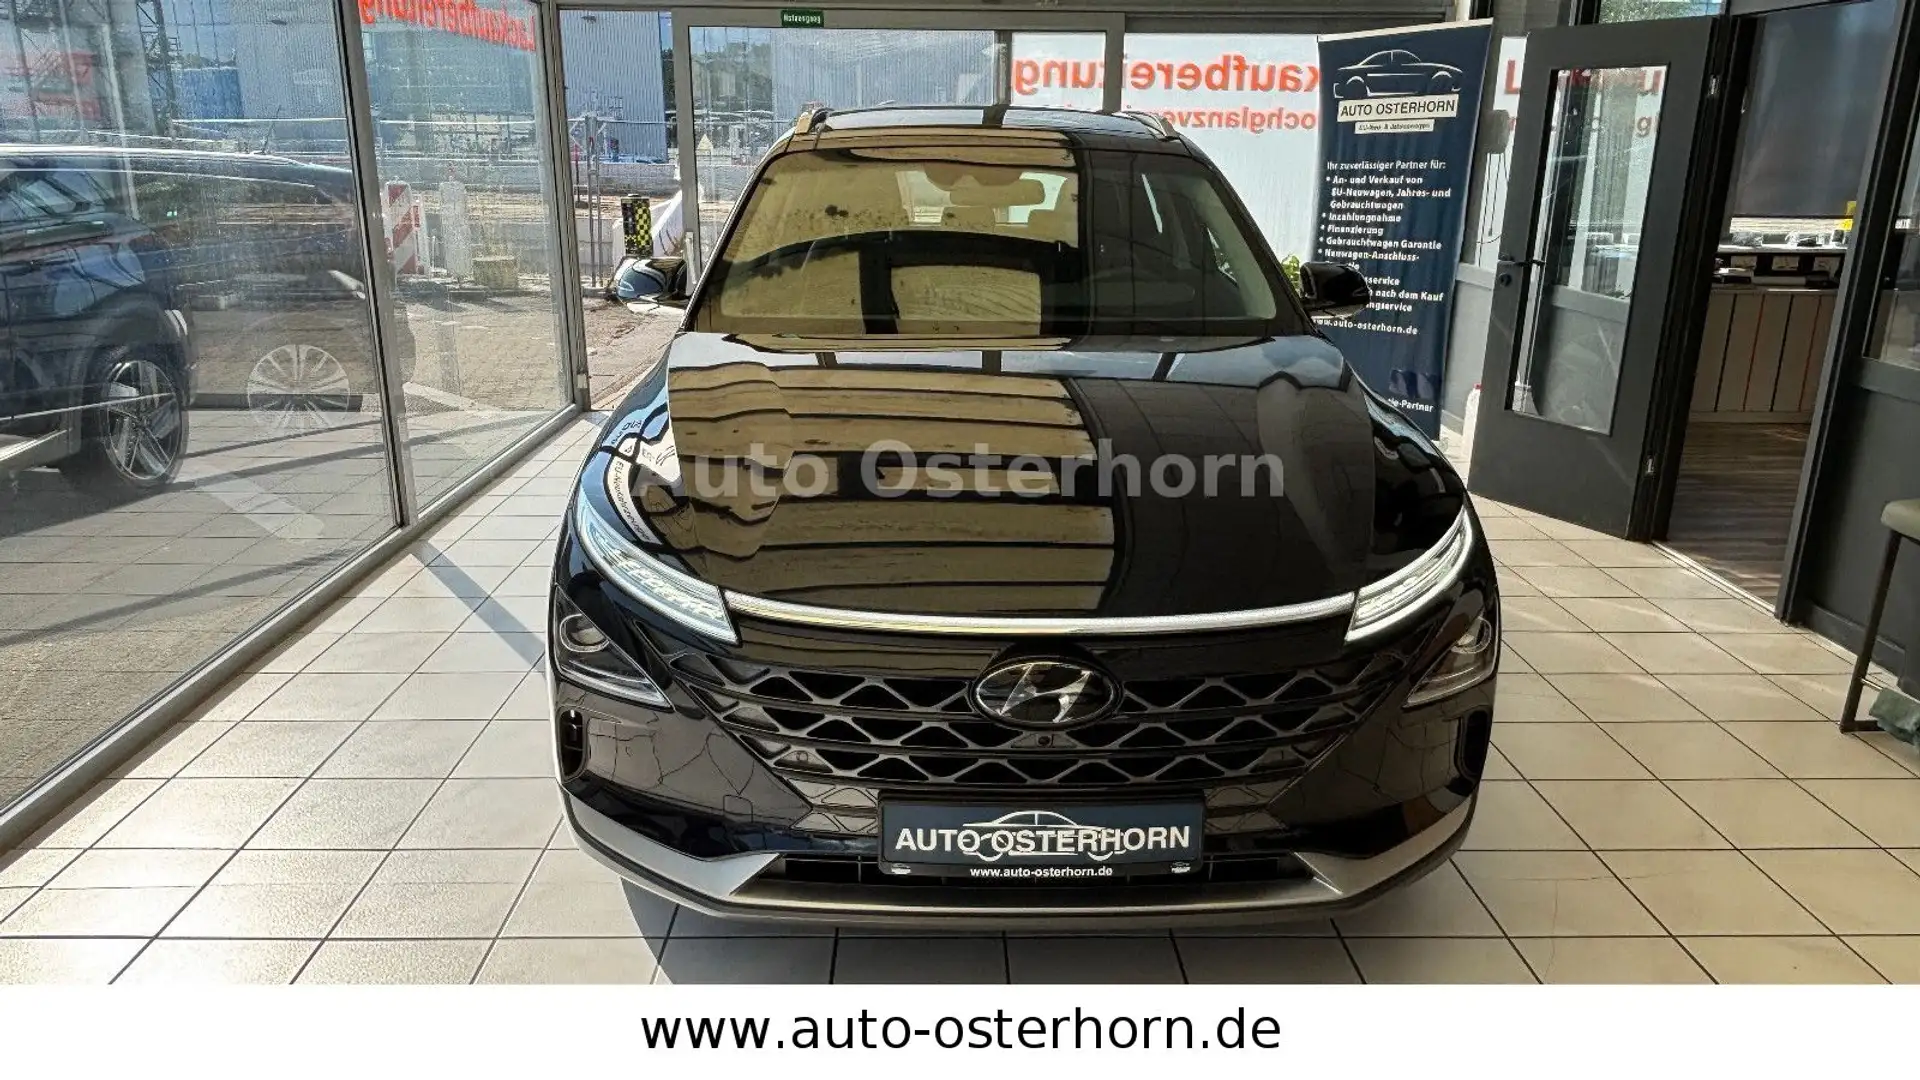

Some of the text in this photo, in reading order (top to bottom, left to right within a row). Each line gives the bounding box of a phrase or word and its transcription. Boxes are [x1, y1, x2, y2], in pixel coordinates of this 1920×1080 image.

[1340, 99, 1455, 117] AUTO OSTERHORN
[1327, 159, 1446, 171] Ihr zuverlässiger Partner für:
[1332, 175, 1347, 184] An-
[1349, 175, 1367, 184] und
[1369, 175, 1404, 184] Verkauf
[1331, 188, 1451, 198] EU-Neuwagen, Jahres- und
[1330, 200, 1404, 211] Gebrauchtwagen
[1328, 212, 1402, 223] Inzahlungnahme
[1327, 224, 1384, 236] Finanzierung
[1326, 236, 1442, 250] Gebrauchtwagen Garantie
[1324, 248, 1420, 262] Neuwagen-Anschluss-
[1375, 289, 1397, 298] nach
[1398, 289, 1418, 300] dem
[1420, 291, 1445, 302] Kauf
[895, 826, 1190, 851] AUTO OSTERHORN
[970, 866, 1113, 878] www.auto-osterhorn.de
